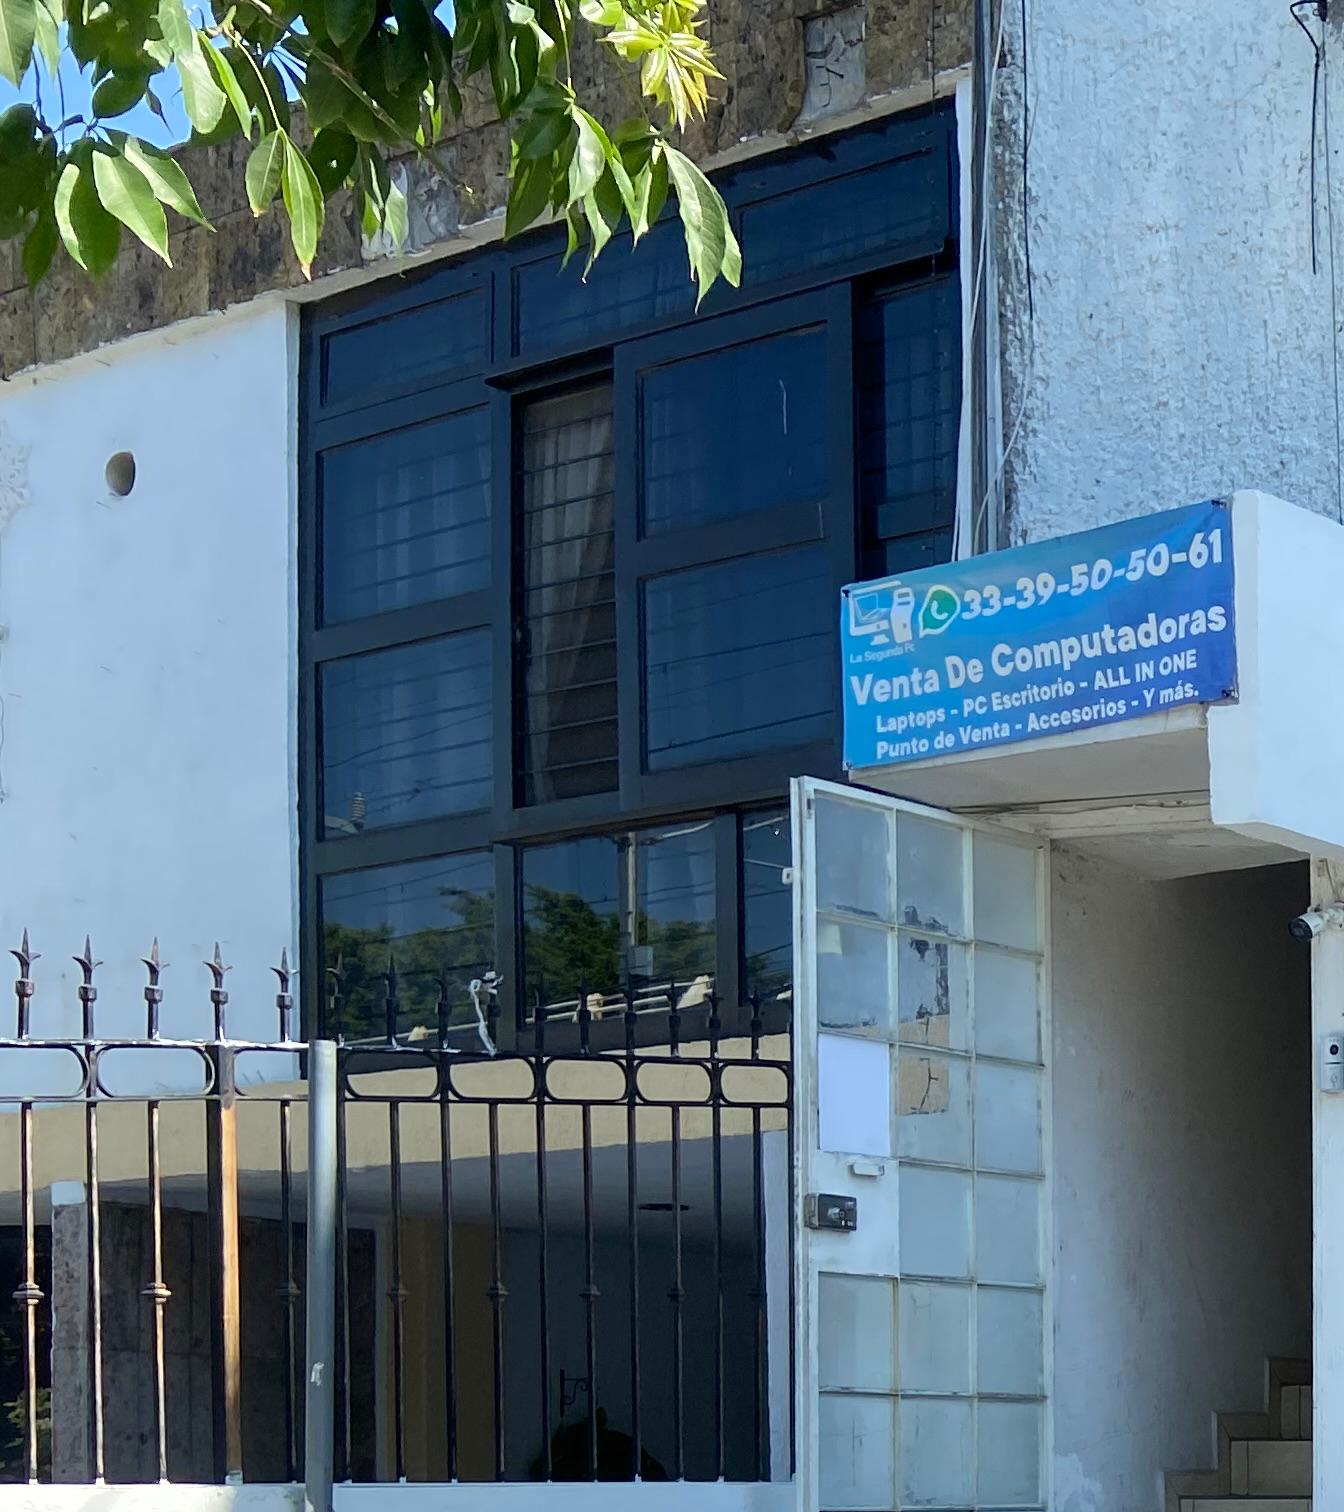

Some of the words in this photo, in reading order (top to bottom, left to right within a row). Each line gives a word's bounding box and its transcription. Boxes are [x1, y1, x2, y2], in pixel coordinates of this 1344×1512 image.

[961, 528, 1222, 620] 33-39-50-50-61
[850, 666, 940, 706] Venta
[944, 655, 983, 689] De
[991, 604, 1227, 677] Computadoras
[876, 706, 945, 734] Laptops
[963, 697, 988, 717] PC
[992, 680, 1075, 712] Escritorio
[1094, 666, 1130, 690] ALL
[1136, 662, 1154, 682] IN
[1159, 648, 1197, 676] ONE
[876, 739, 929, 759] Punto
[933, 731, 955, 750] de
[960, 721, 1010, 743] Venta
[1027, 699, 1126, 732] Accesorios
[1143, 689, 1156, 708] Y
[1159, 681, 1199, 703] más.
